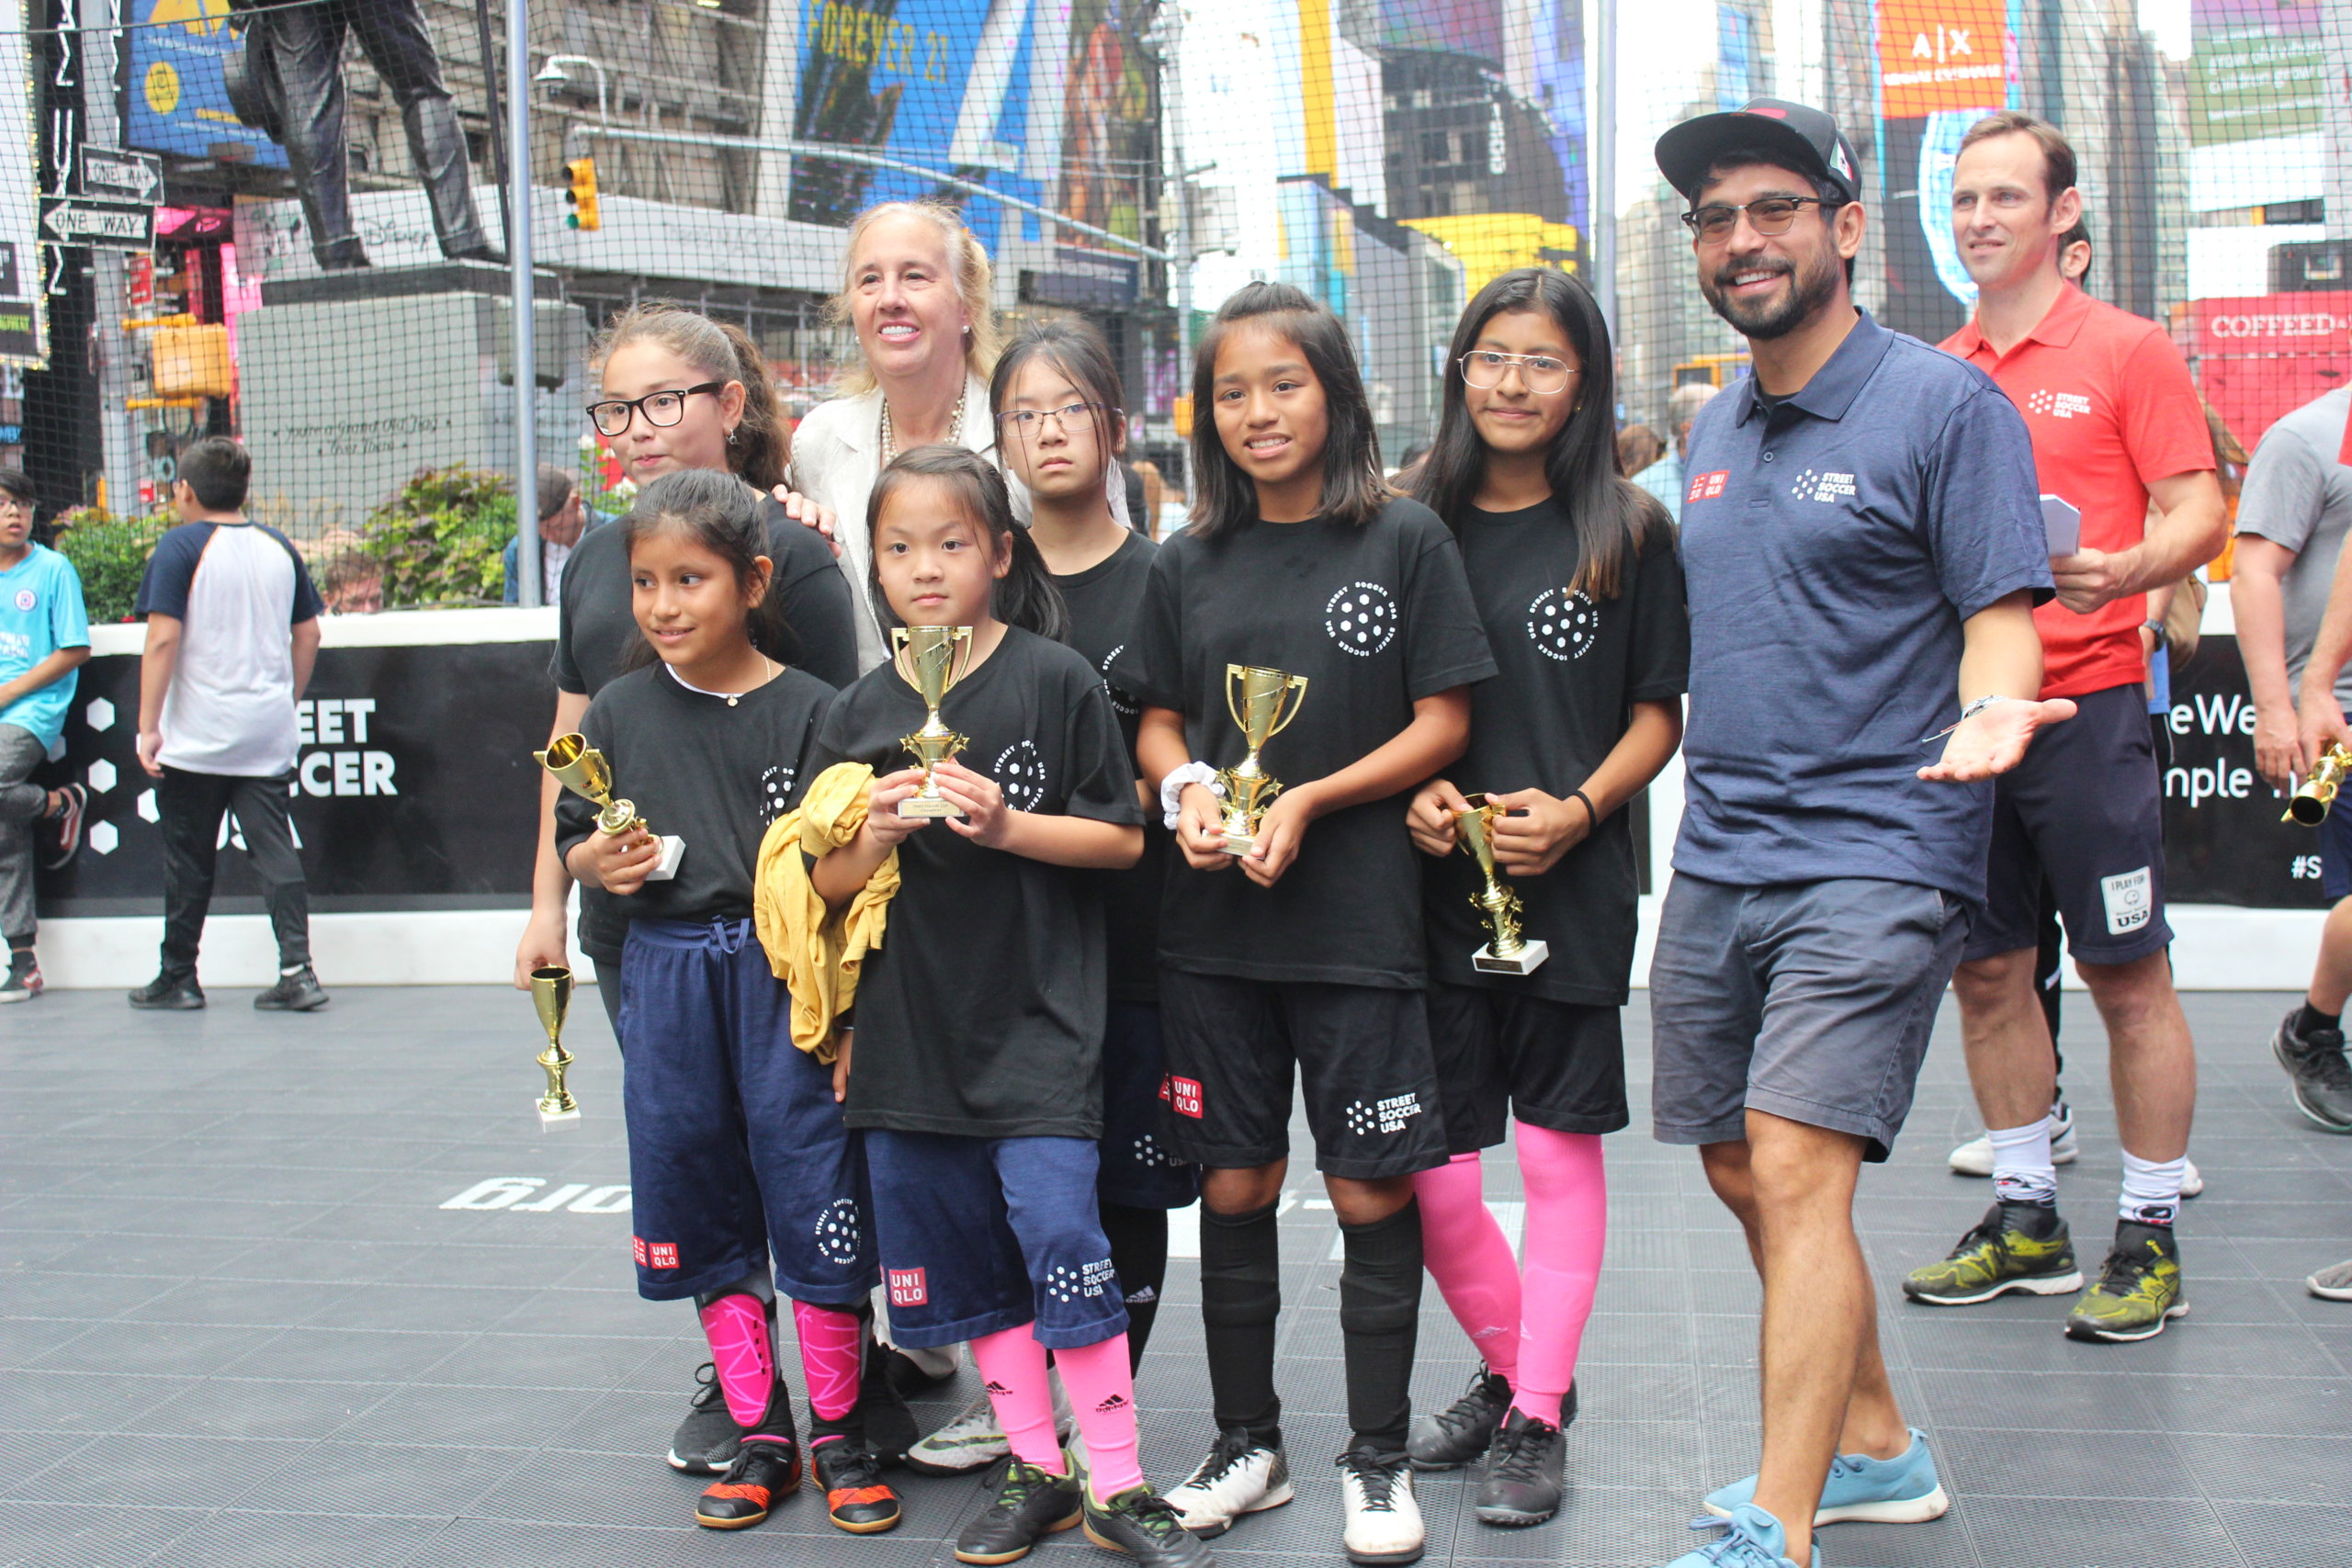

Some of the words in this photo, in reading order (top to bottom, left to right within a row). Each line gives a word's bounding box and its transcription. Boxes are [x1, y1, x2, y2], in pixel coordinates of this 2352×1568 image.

[808, 0, 915, 75] FOREVER
[924, 30, 947, 84] 21
[93, 162, 117, 182] ONE
[55, 212, 87, 231] ONE
[102, 214, 137, 232] WAY
[2211, 312, 2335, 338] COFFEED
[2054, 400, 2091, 414] SOCCER
[2056, 392, 2090, 405] STREET
[2052, 409, 2073, 419] USA
[1709, 473, 1724, 485] UNI
[1821, 472, 1855, 484] STREET
[1704, 485, 1722, 497] QLO
[1814, 491, 1836, 503] USA
[1817, 481, 1857, 496] SOCCER
[1326, 586, 1349, 614] STREET
[1355, 581, 1388, 598] SOCCER
[1529, 589, 1555, 614] STREET
[1562, 587, 1593, 606] SCCER
[295, 698, 376, 744] EET
[2169, 694, 2256, 735] eWe
[994, 745, 1015, 773] STREET
[288, 750, 399, 797] CER
[2290, 855, 2323, 879] #S
[2115, 878, 2132, 891] PLAY
[2116, 910, 2148, 928] USA
[1175, 1081, 1196, 1098] UNI
[1176, 1096, 1199, 1112] QLO
[1377, 1092, 1416, 1111] STREET
[1379, 1103, 1422, 1122] SOCCER
[1380, 1119, 1407, 1134] USA
[815, 1209, 830, 1235] STREET
[652, 1247, 673, 1256] UNI
[654, 1257, 676, 1268] QLO
[891, 1273, 920, 1288] UNI
[1083, 1269, 1115, 1286] SOCCER
[894, 1288, 923, 1304] QLO
[1096, 1398, 1129, 1414] adidas
